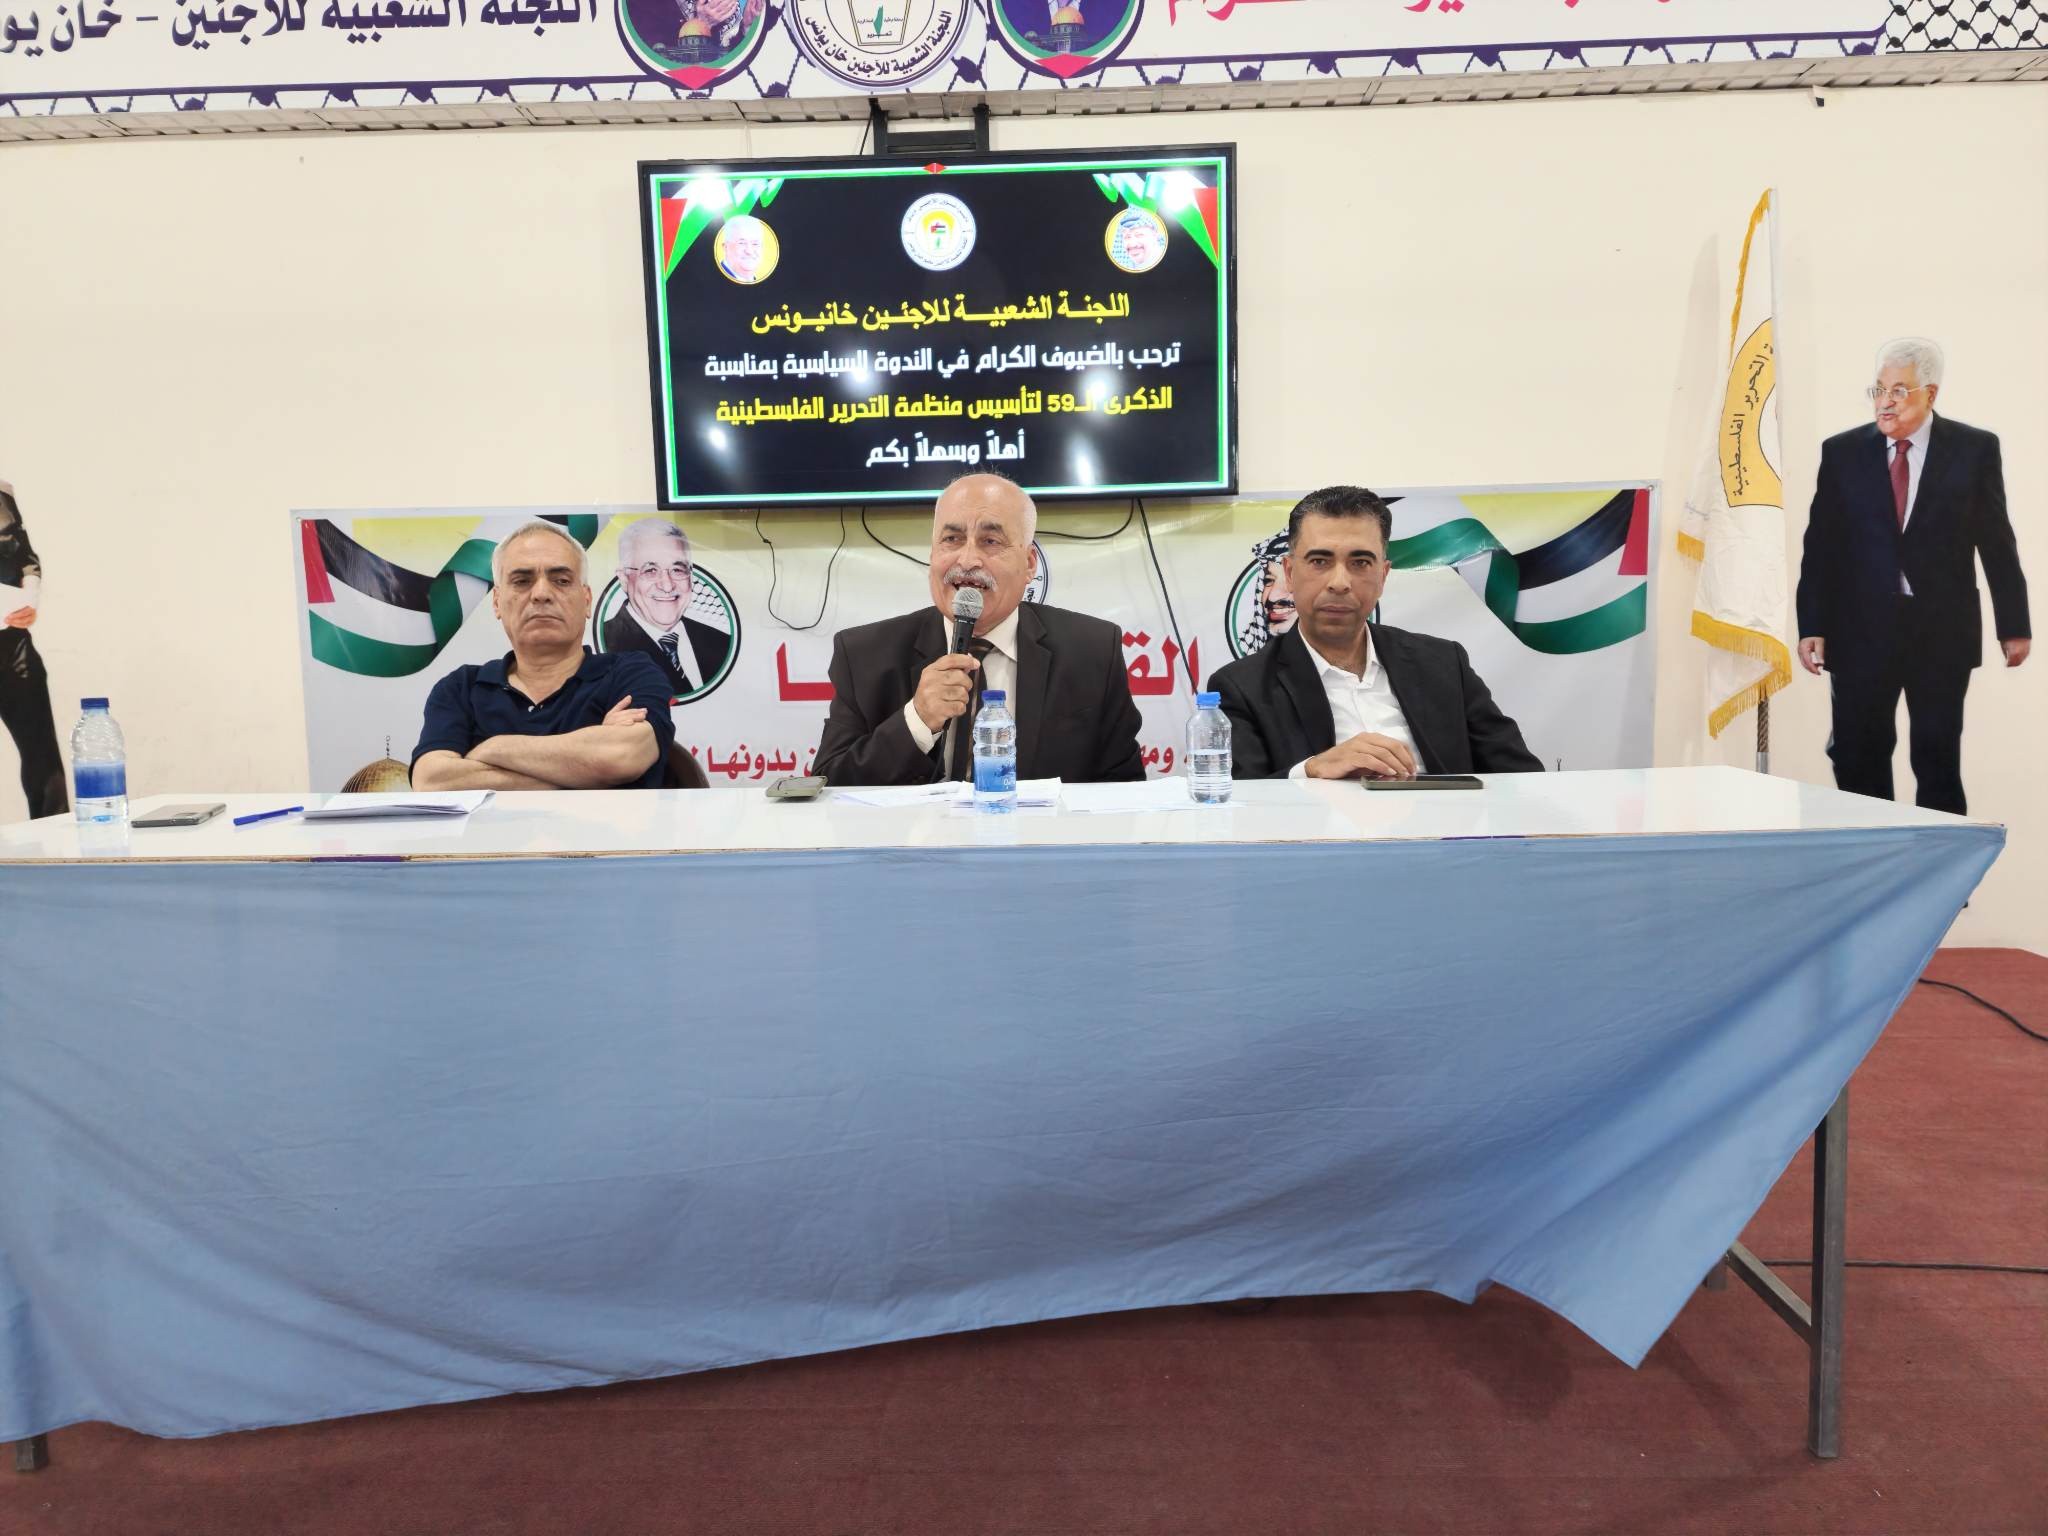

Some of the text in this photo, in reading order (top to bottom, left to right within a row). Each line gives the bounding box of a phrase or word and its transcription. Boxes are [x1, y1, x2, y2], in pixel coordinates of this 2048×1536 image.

[50, 0, 122, 52] خان
[751, 290, 1130, 334] اللجنة الشعبية للاجئين خانيونس
[704, 342, 1182, 381] ترحب بالضيوف الكرام في الندوة السياسية بمناسبة
[716, 396, 824, 425] الفلسطينية
[829, 395, 889, 423] التحرير
[895, 393, 963, 417] منظمة
[968, 385, 1042, 419] لتأسيس
[1103, 386, 1173, 414] الذكرى
[865, 438, 909, 468] بكم
[1728, 413, 1750, 496] الفلسطينية
